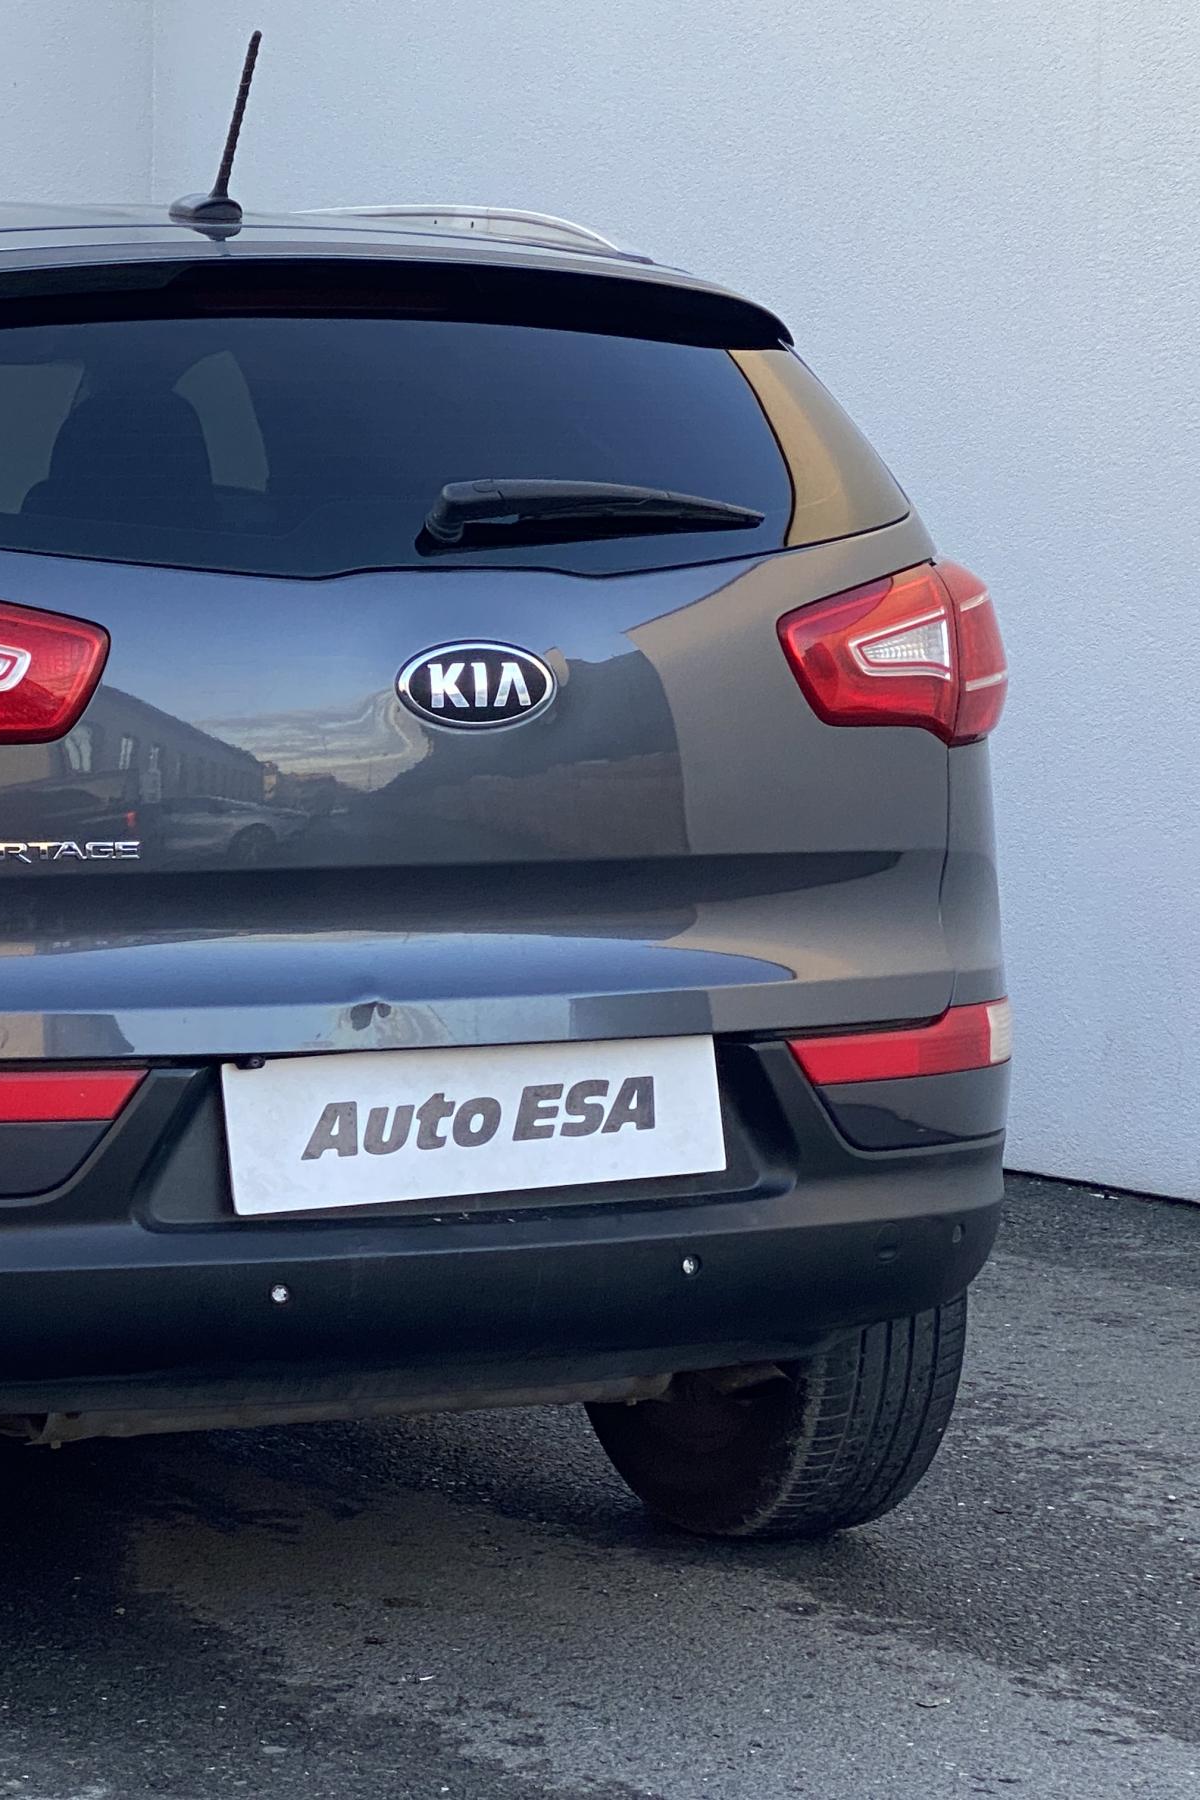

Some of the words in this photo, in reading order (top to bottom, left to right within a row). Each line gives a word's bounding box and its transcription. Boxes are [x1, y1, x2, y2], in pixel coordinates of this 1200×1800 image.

[427, 661, 532, 708] KIA
[300, 1092, 502, 1161] Auto
[512, 1075, 656, 1142] ESA
